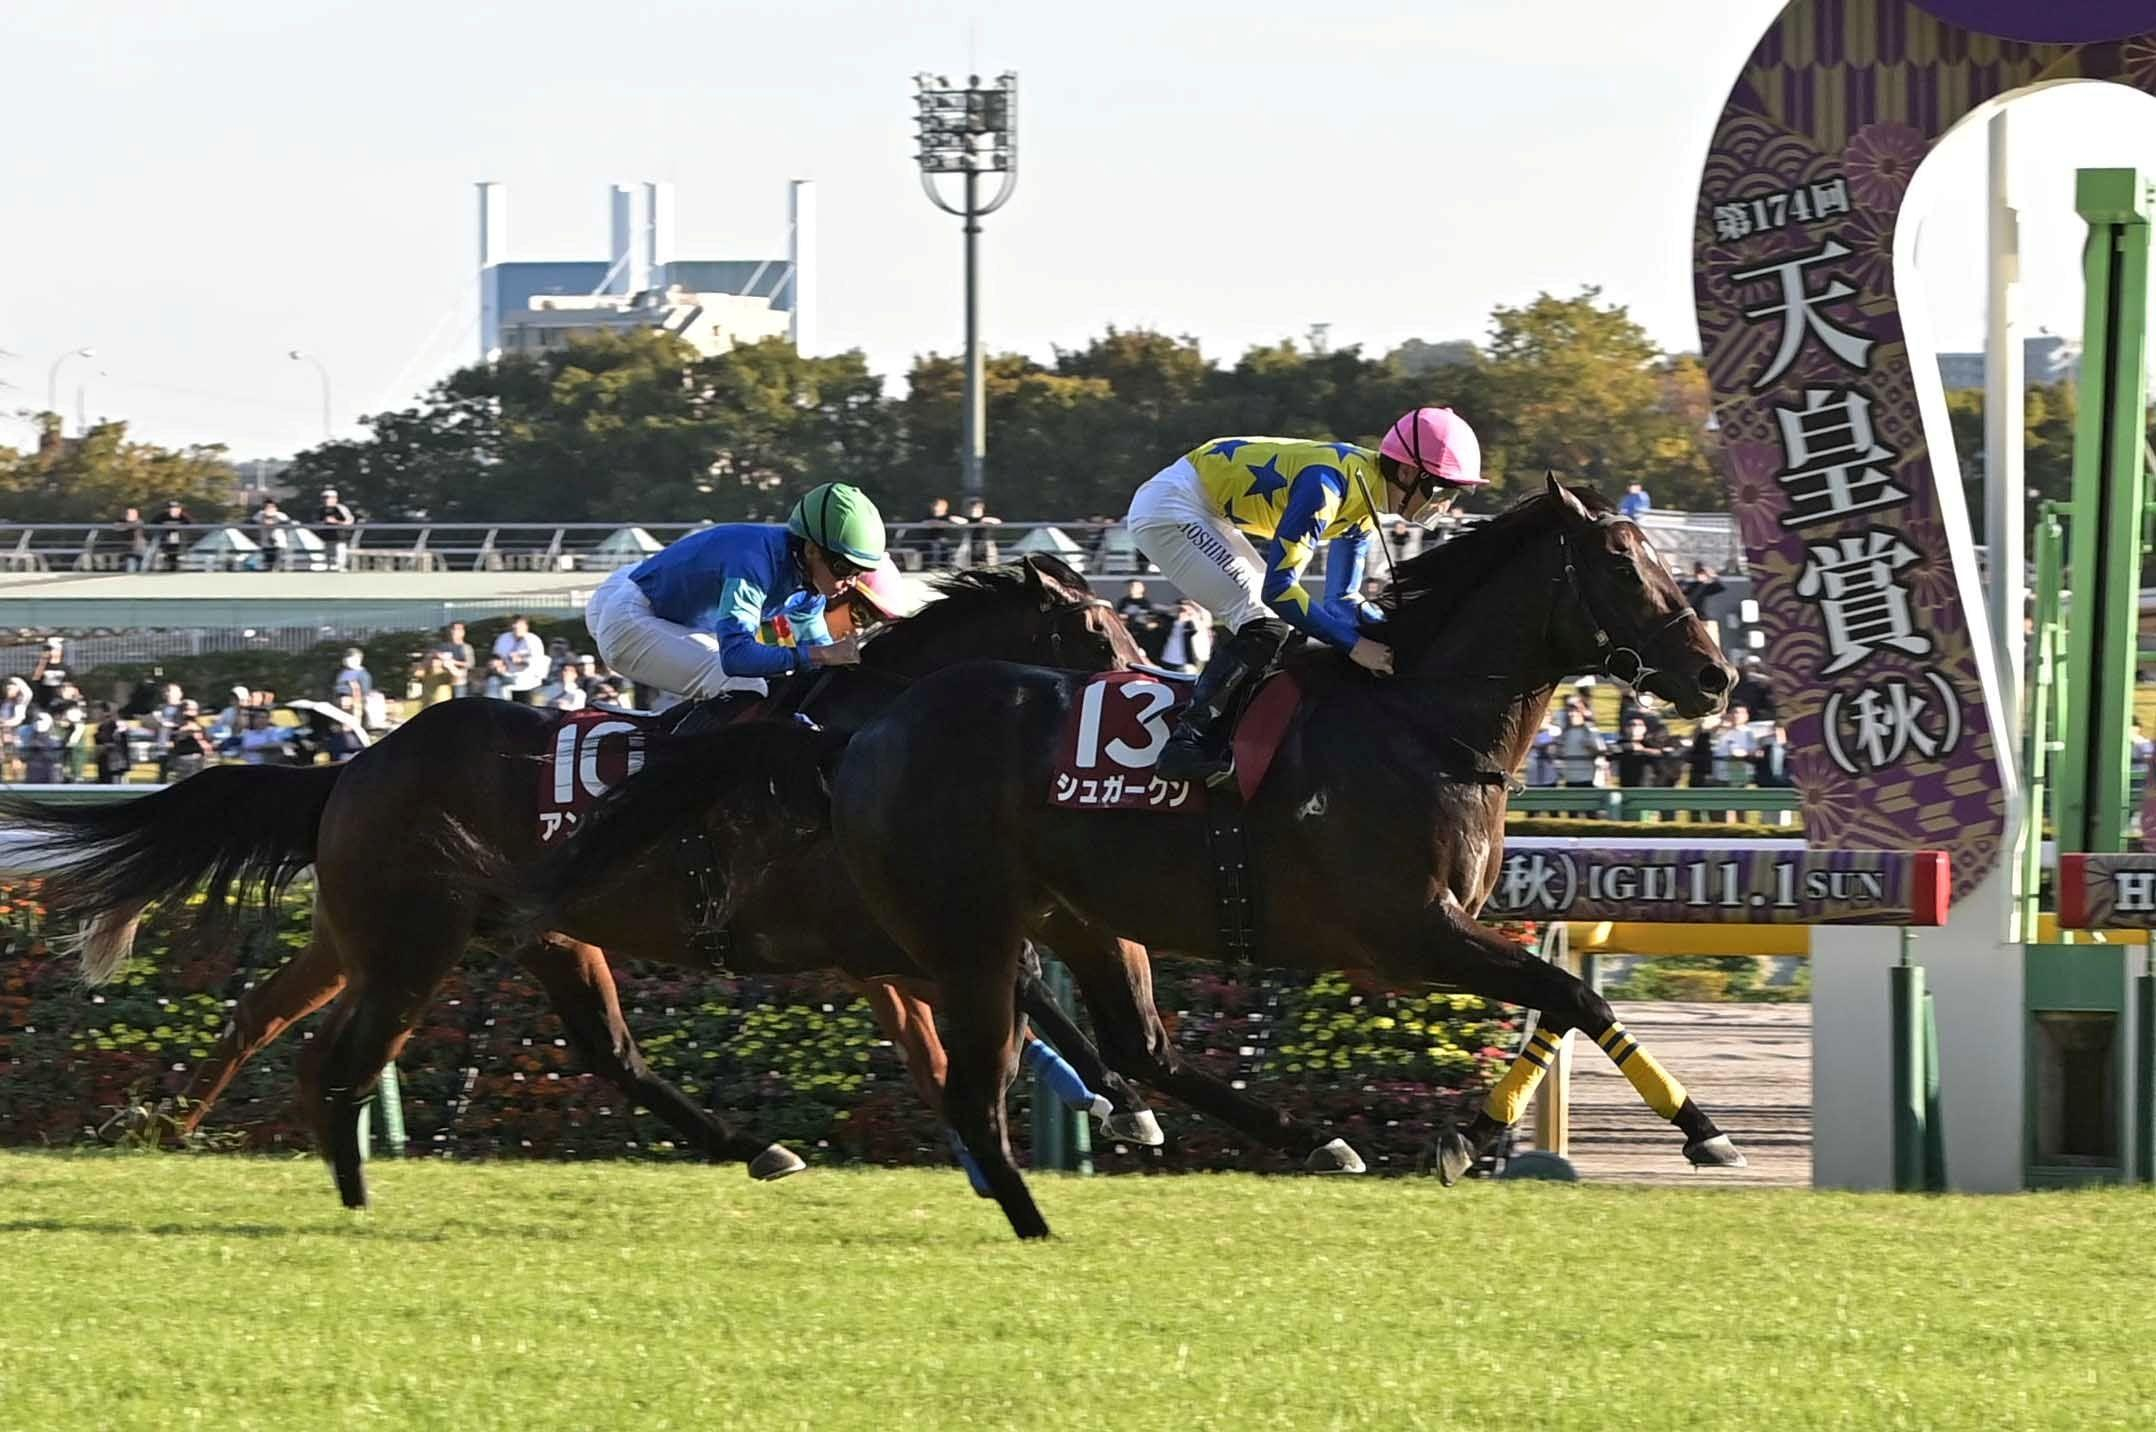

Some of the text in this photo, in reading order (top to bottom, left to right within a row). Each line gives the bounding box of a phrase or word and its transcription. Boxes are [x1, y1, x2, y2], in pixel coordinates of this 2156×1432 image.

[1713, 178, 1850, 241] 第174回
[1075, 679, 1176, 769] 13
[1056, 773, 1190, 807] シュガークン
[1487, 853, 1577, 911] 秋)
[1686, 862, 1800, 906] 11.1
[1805, 870, 1884, 900] SUN
